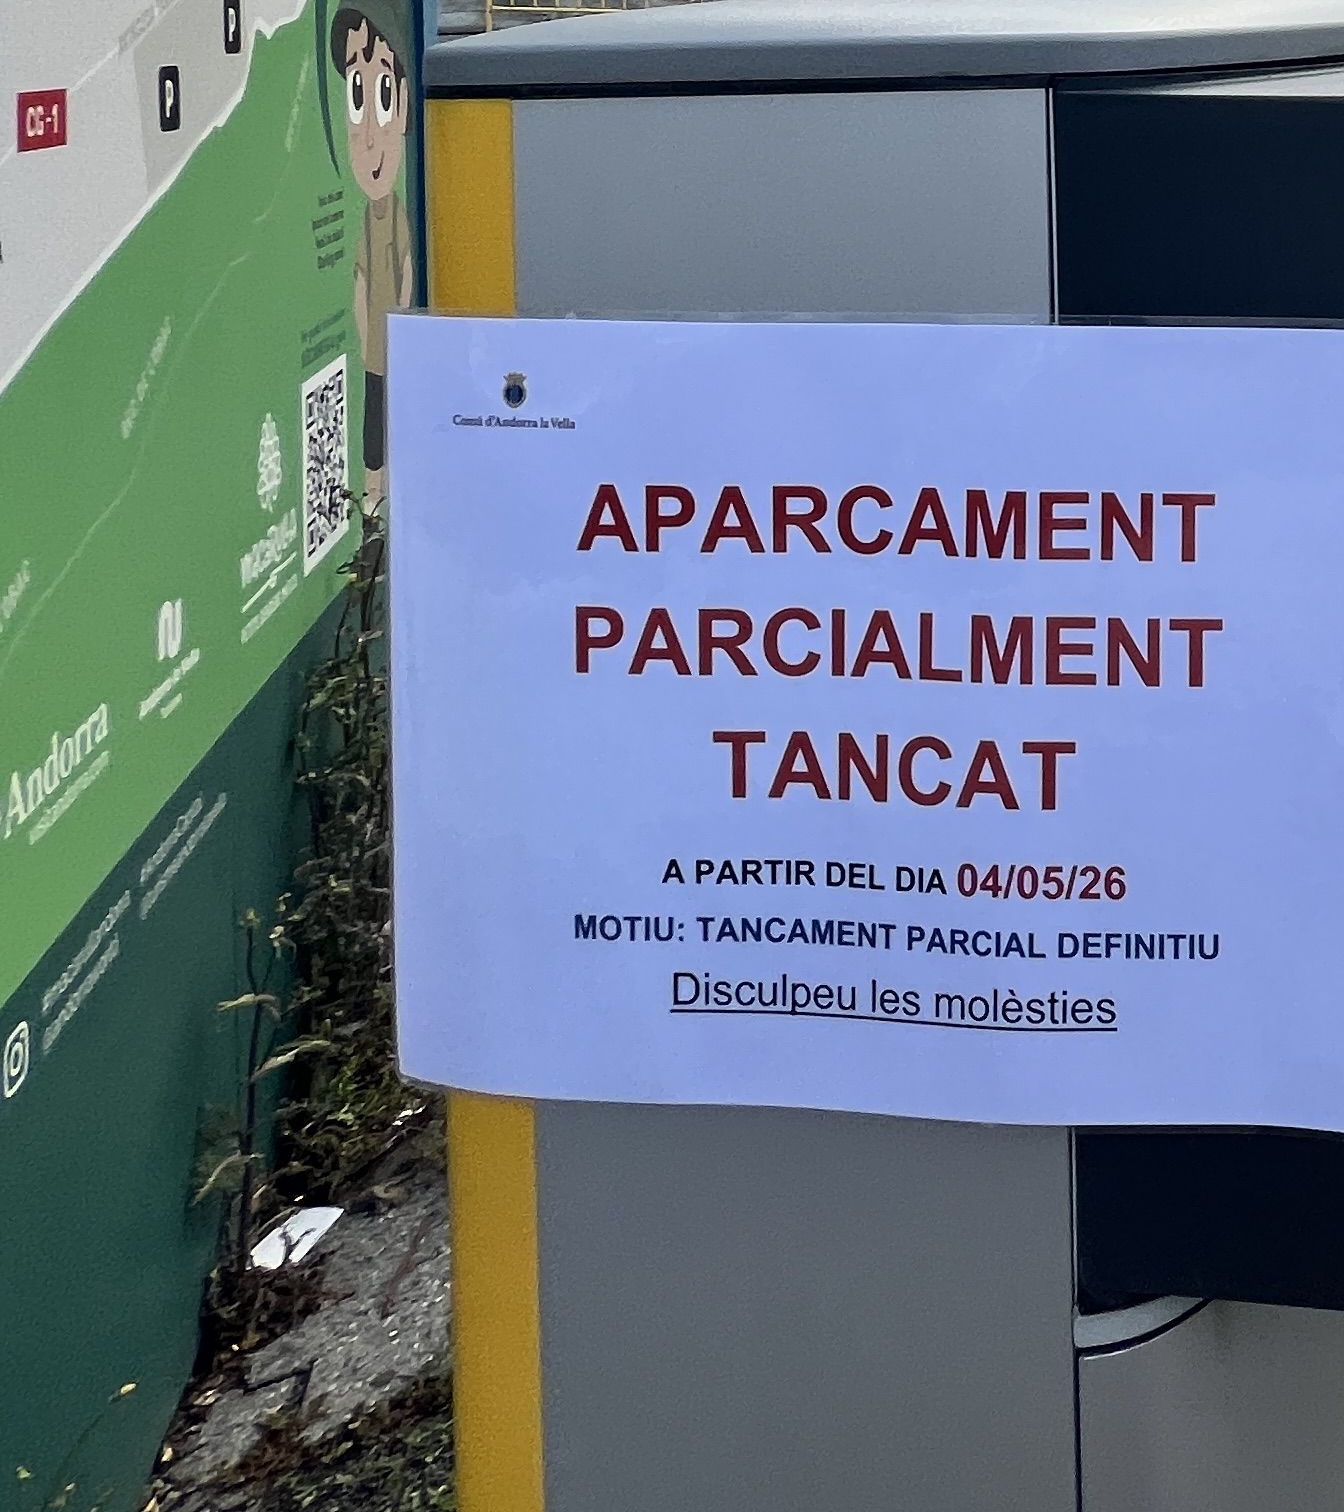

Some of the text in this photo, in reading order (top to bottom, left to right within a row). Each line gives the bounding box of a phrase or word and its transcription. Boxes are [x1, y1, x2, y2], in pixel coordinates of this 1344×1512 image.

[576, 483, 1216, 563] APARCAMENT
[575, 605, 1224, 688] PARCIALMENT
[4, 703, 110, 840] Andorra
[712, 730, 1077, 811] TANCAT
[661, 859, 1127, 901] A PARTIR DEL DIA 04/05/26
[574, 913, 1220, 961] MOTIU: TANCAMENT PARCIAL DEFINITIU
[671, 972, 1118, 1027] Disculpeu les molèsties
